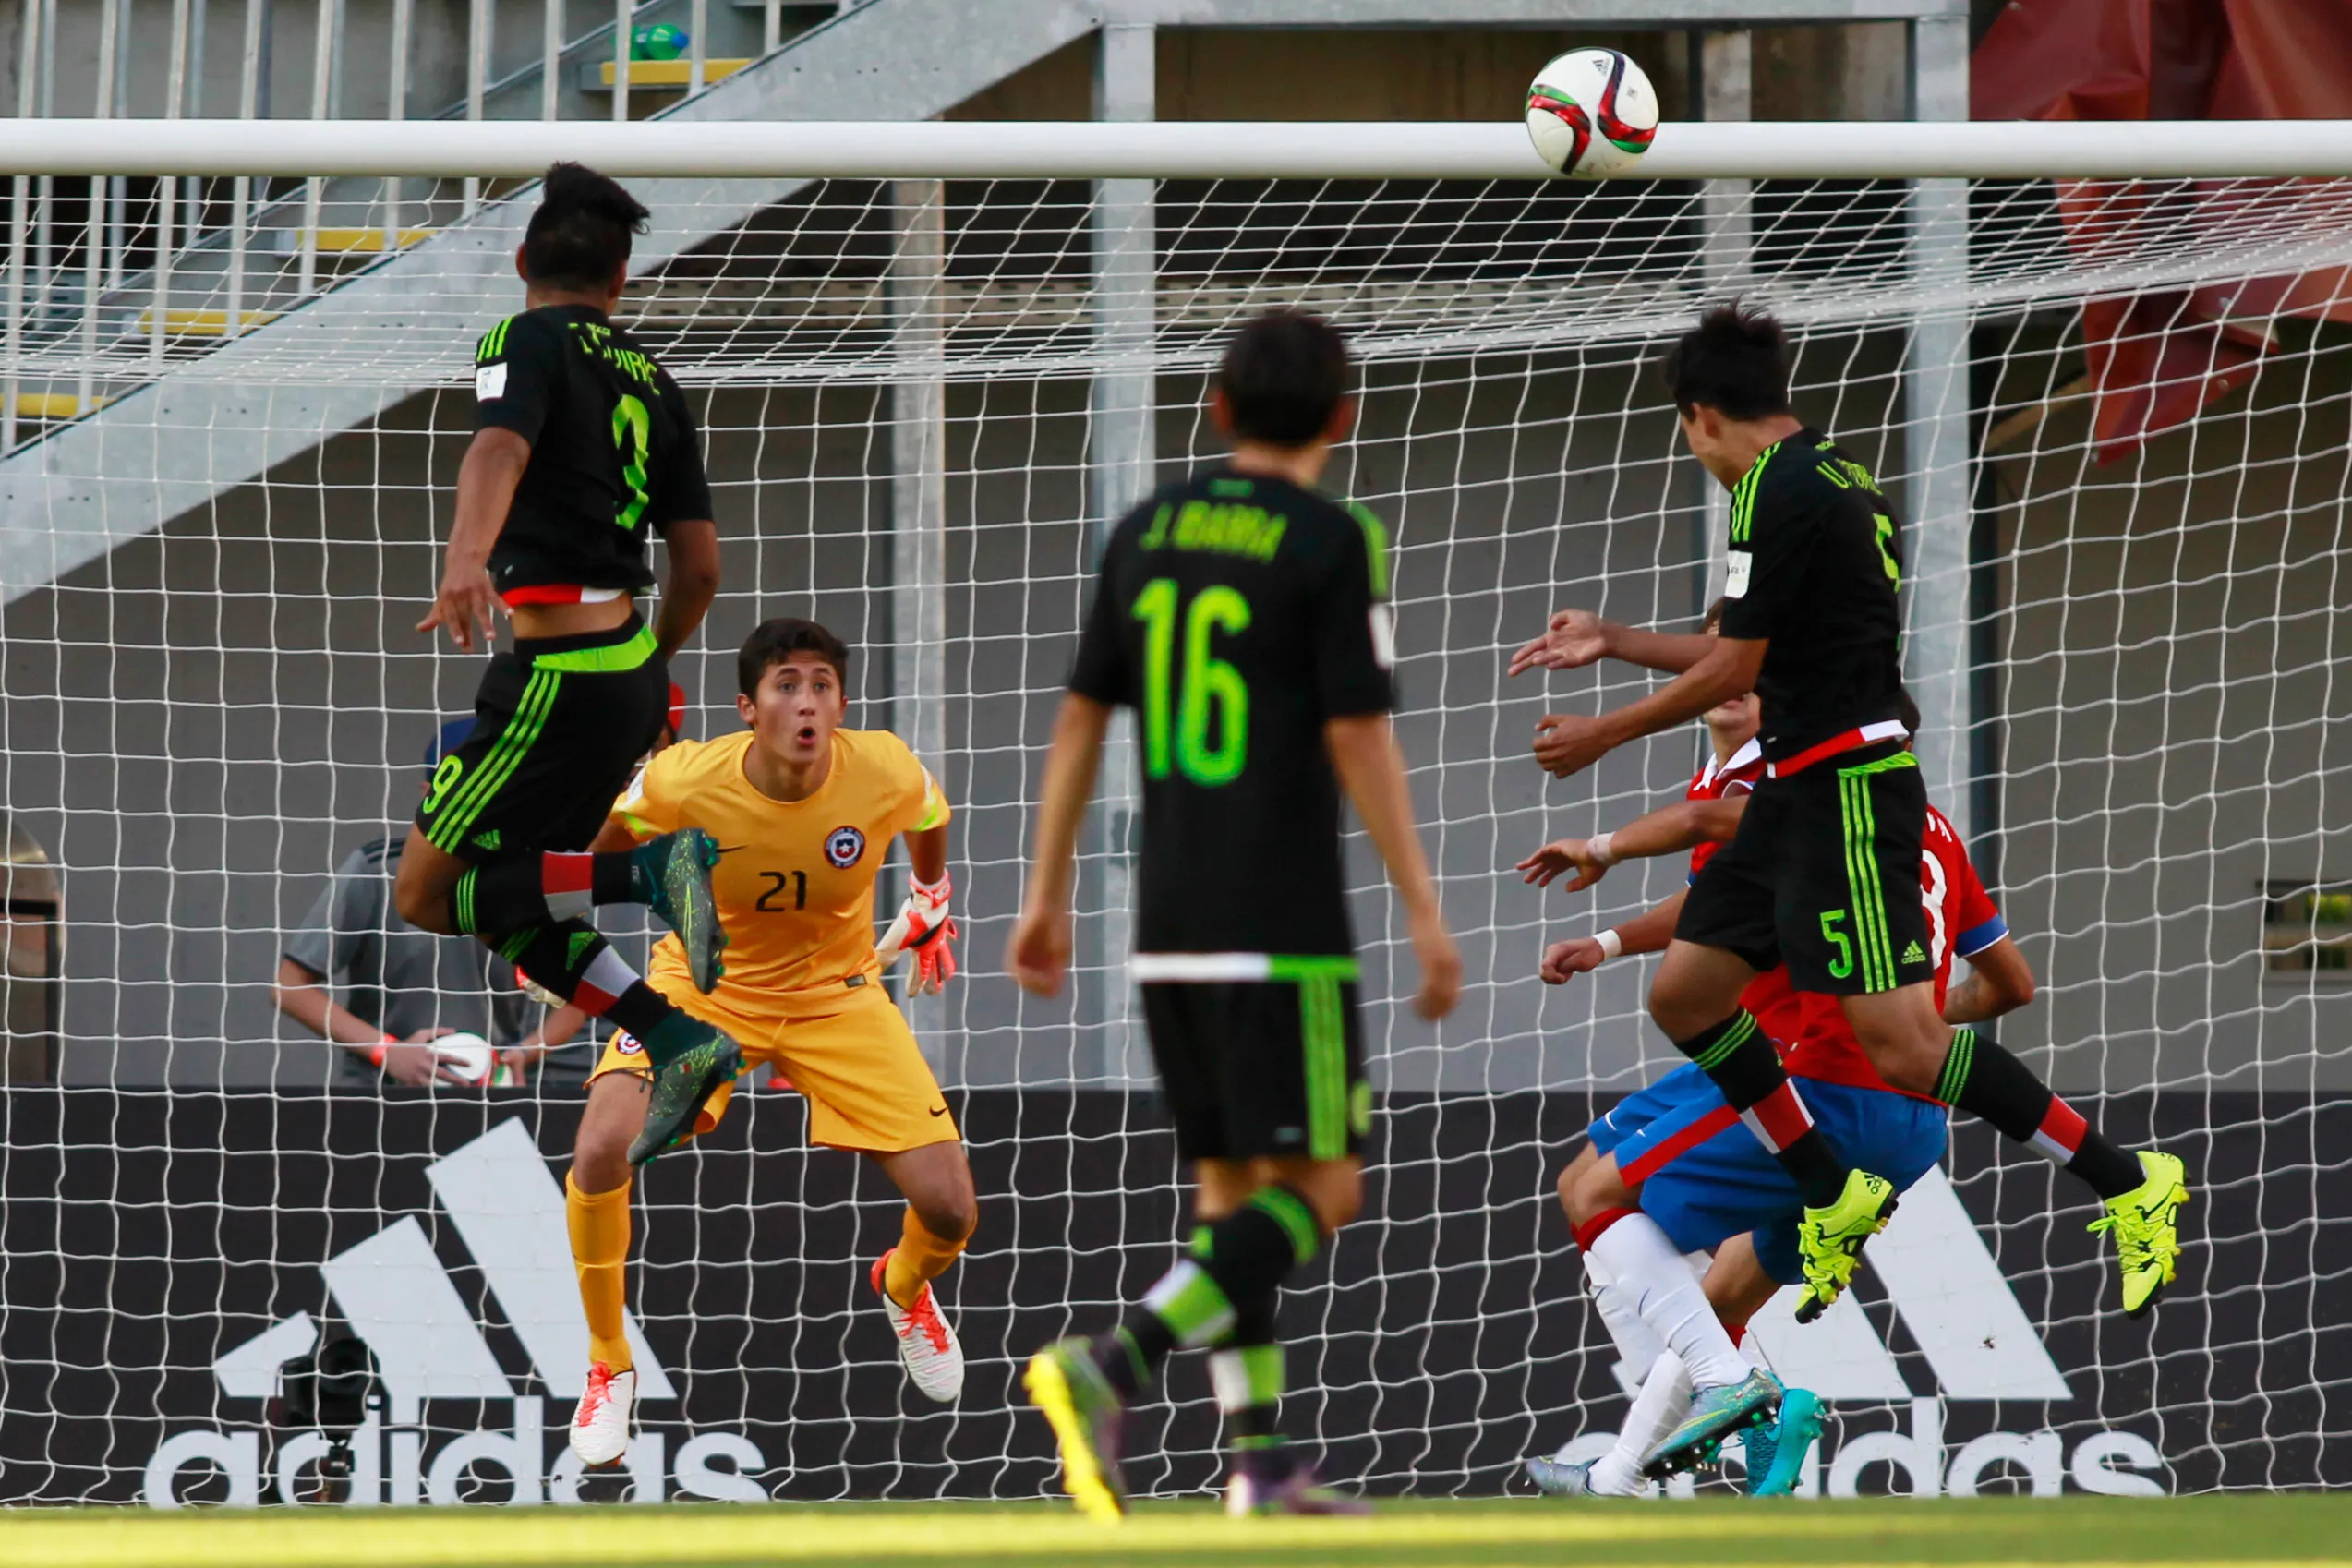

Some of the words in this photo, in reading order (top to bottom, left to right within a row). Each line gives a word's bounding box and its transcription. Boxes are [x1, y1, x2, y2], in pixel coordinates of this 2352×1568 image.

[1130, 576, 1252, 787] 16
[423, 754, 463, 814] 9
[755, 871, 806, 912] 21
[1820, 909, 1853, 979] 5
